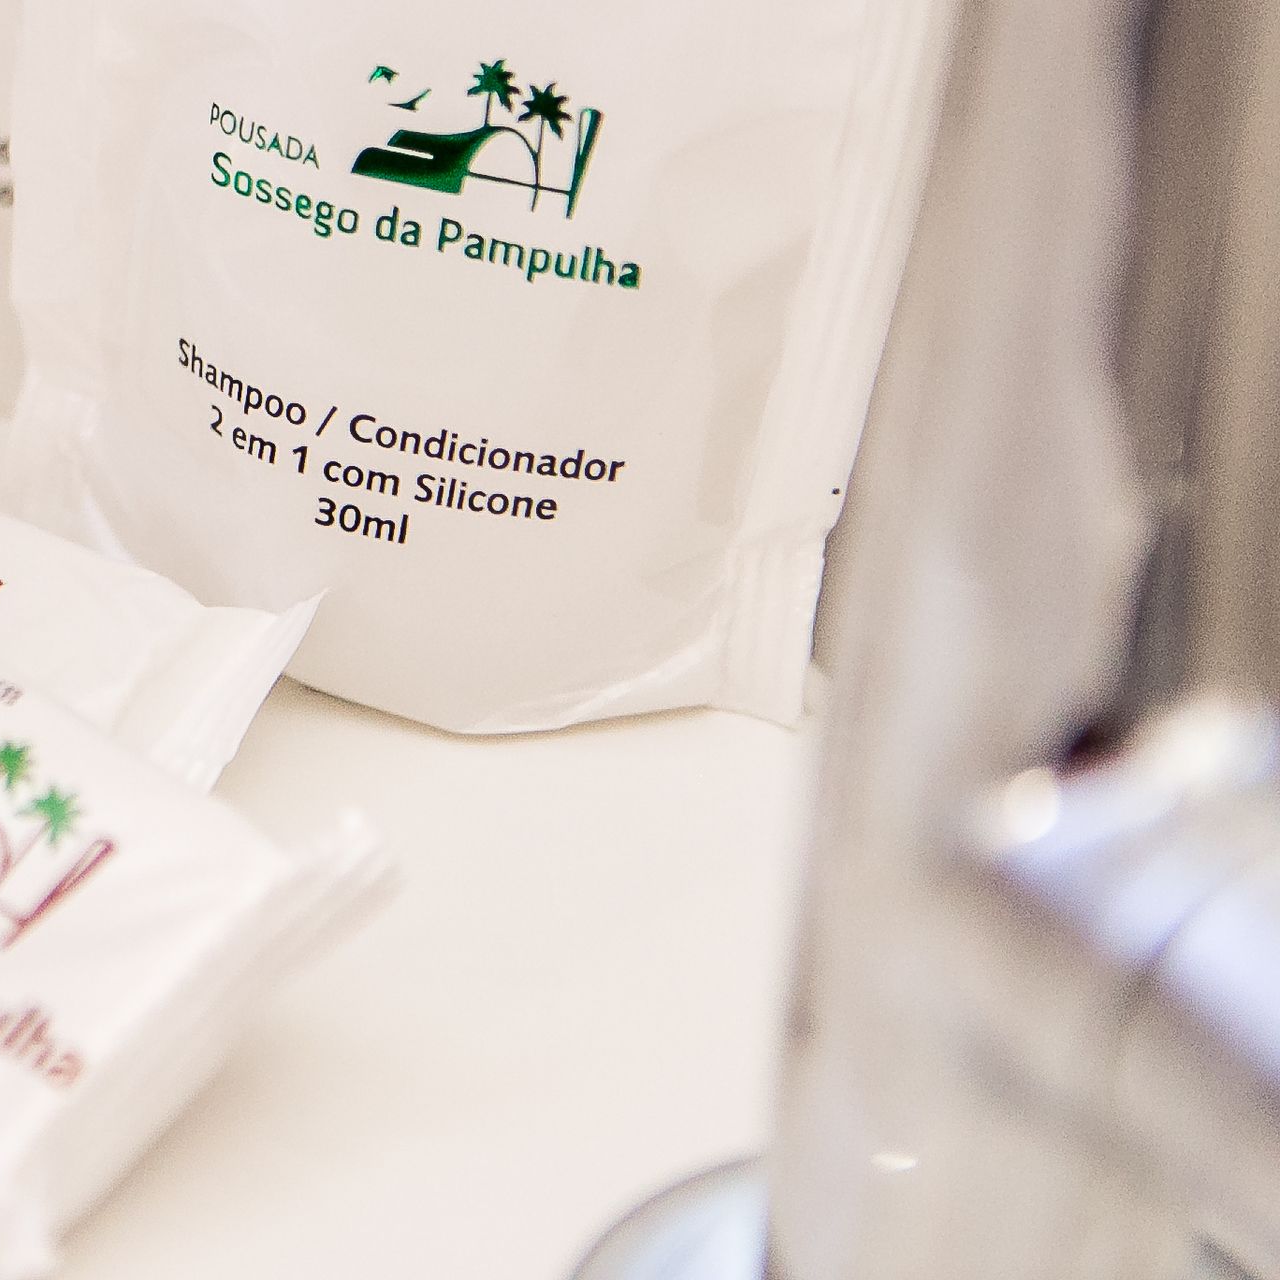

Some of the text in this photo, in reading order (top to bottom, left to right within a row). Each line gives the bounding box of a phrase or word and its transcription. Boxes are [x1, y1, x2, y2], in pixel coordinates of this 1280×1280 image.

[209, 101, 320, 170] POUSADA
[210, 151, 641, 290] Sossego da Pampulha
[177, 337, 627, 484] Shampoo / Condicionador
[209, 404, 559, 521] 2 em 1 com Silicone
[313, 497, 408, 545] 30ml
